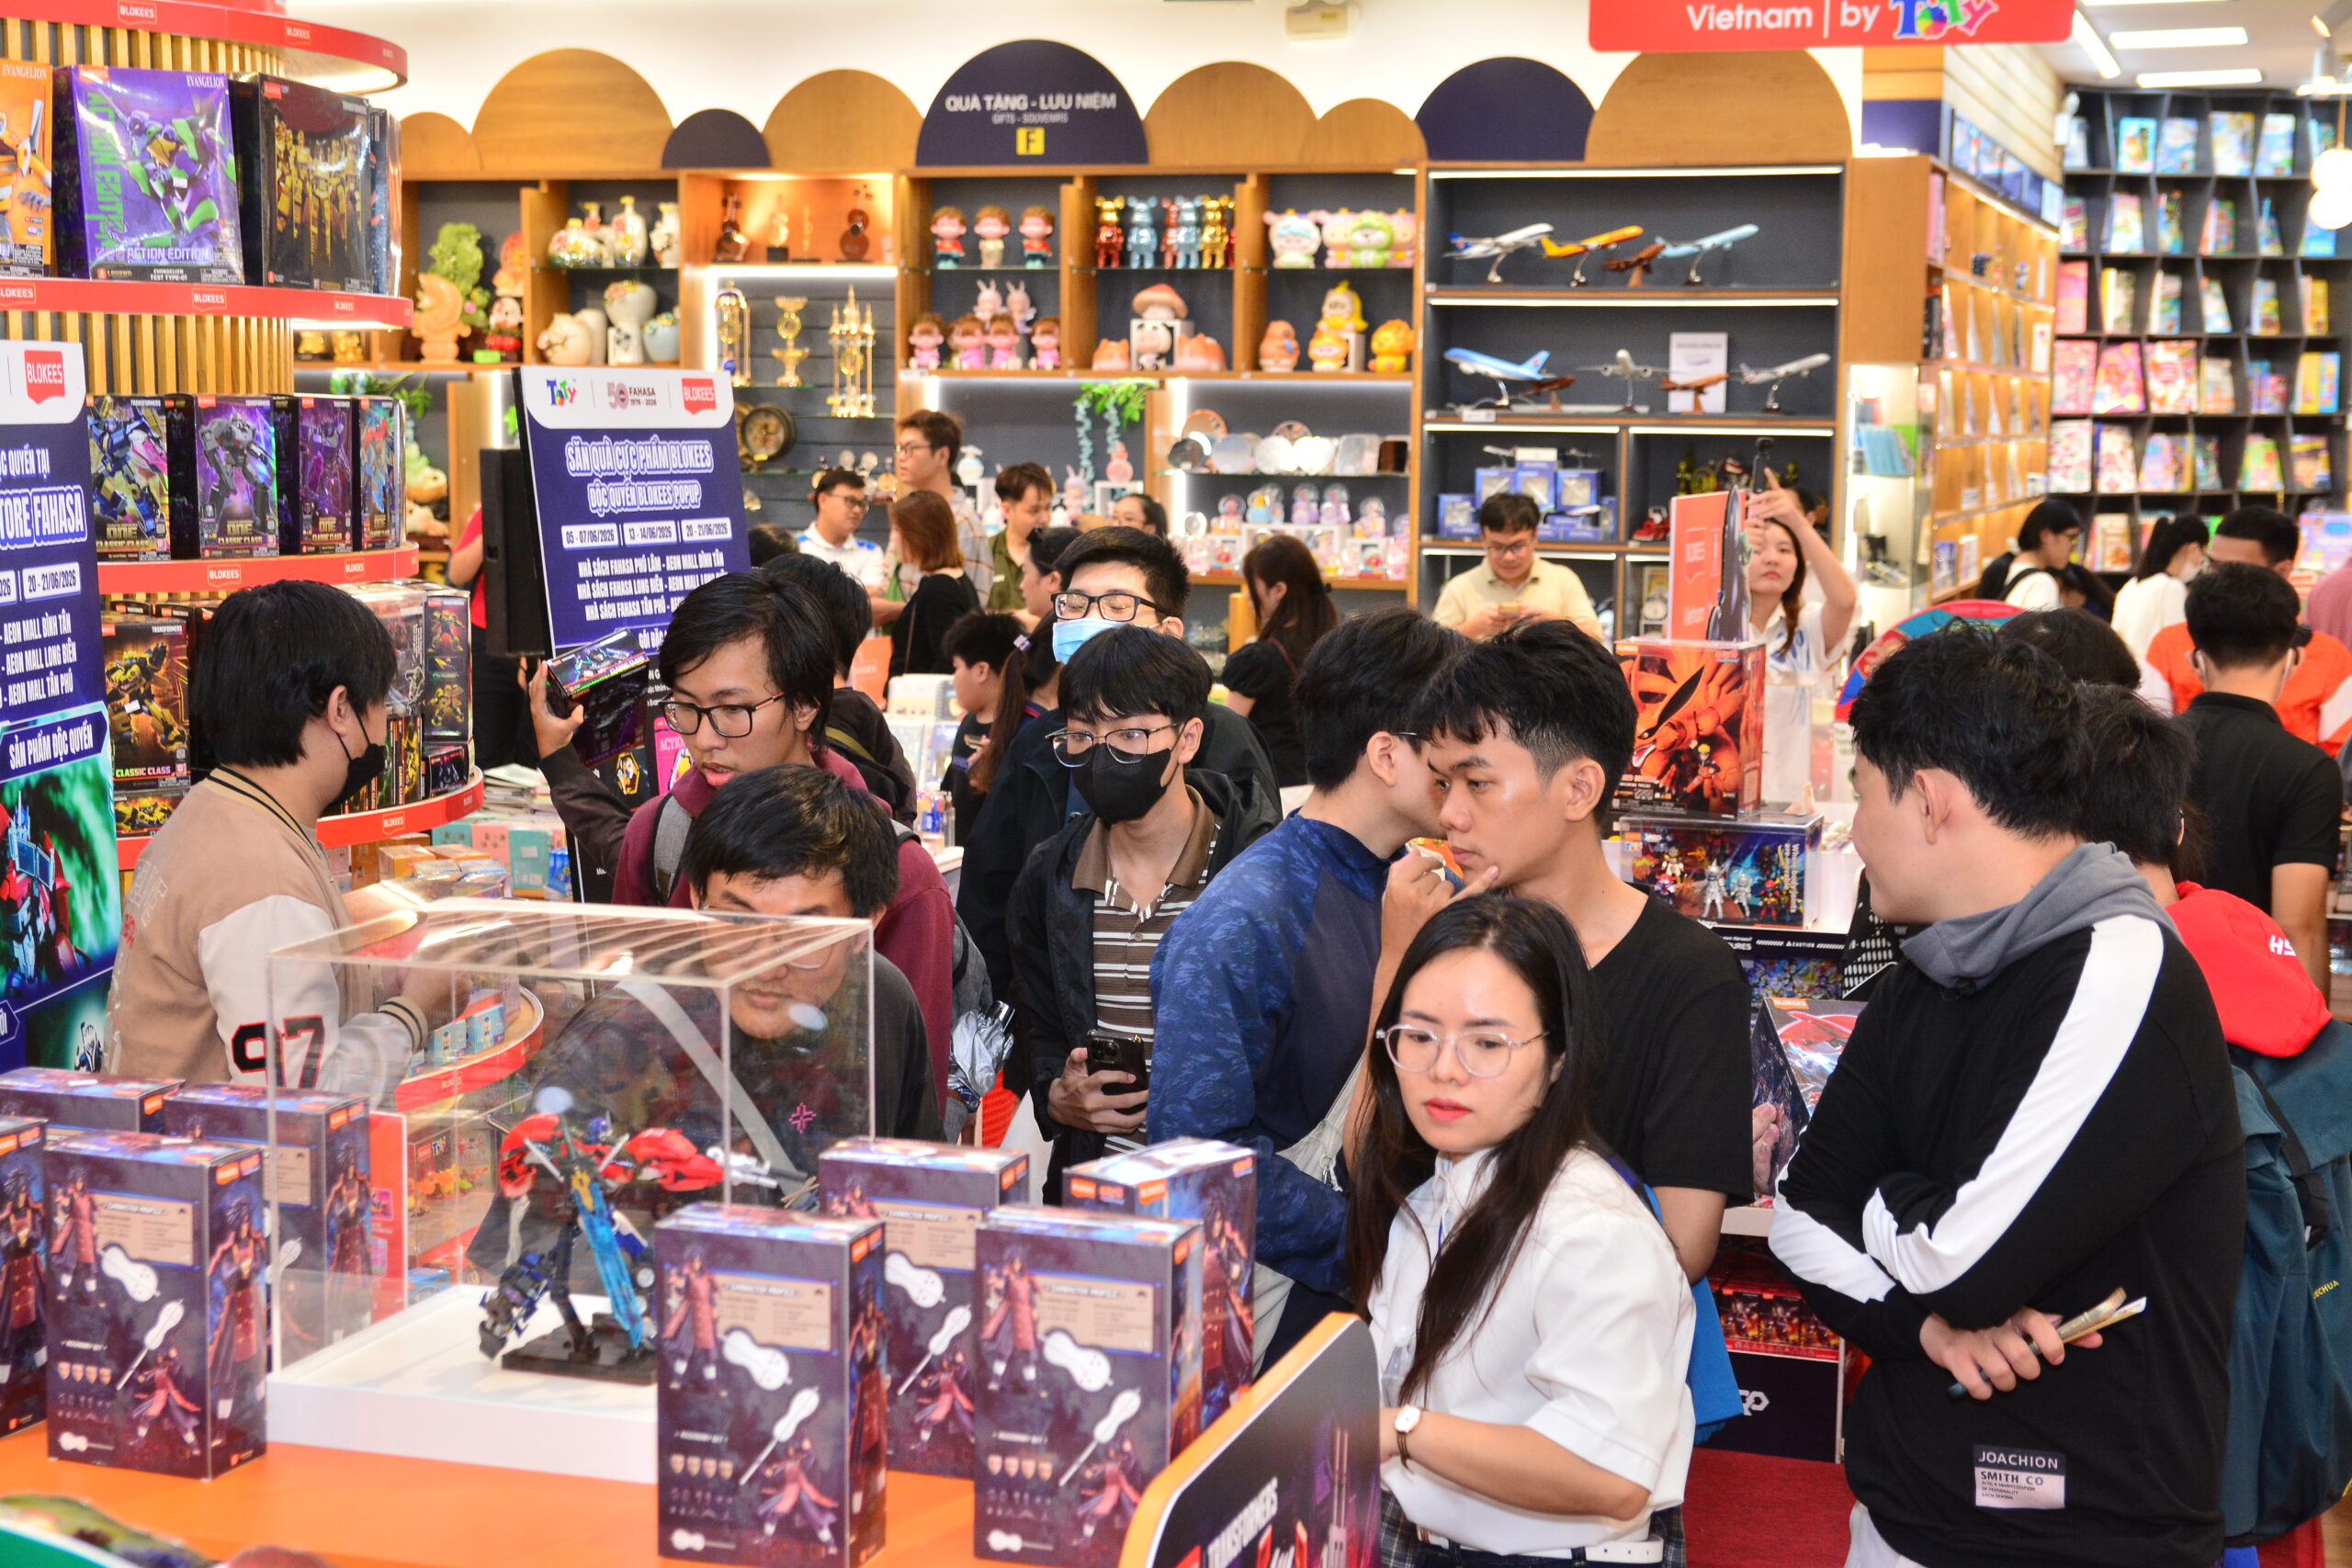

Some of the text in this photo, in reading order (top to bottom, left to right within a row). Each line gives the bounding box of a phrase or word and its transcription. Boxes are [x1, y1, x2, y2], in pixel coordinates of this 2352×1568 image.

[119, 6, 154, 18] BLOKEES
[1687, 5, 1813, 30] Vietnam
[1840, 3, 1879, 31] by
[286, 27, 310, 39] BLOKEES
[2, 65, 47, 78] EVANGELION
[187, 74, 225, 88] EVANGELION
[127, 247, 209, 259] ACTION EDITION
[0, 288, 34, 299] LOKEES
[194, 293, 224, 304] BLOKEES
[26, 362, 63, 385] BLOKEES
[607, 382, 656, 410] 50 FAHASA
[684, 385, 715, 402] BLOKEES
[8, 443, 36, 477] QUYỀN
[36, 448, 50, 479] TẠI
[568, 437, 712, 477] SĂN QUÀ CỰC PHẨM BLOKEES
[589, 479, 700, 514] ĐỘC QUYỀN BLOKEES POPUP
[0, 492, 85, 540] TORE FAHASA
[566, 528, 615, 544] 05 07/06/2026
[629, 525, 672, 540] 13 14/06/2026
[686, 523, 728, 536] 20 21/06/2026
[243, 536, 262, 544] CLASS
[209, 570, 239, 580] BLOKEES
[345, 564, 364, 573] BLOKEES
[578, 558, 593, 578] NHÀ
[593, 557, 611, 577] SÁCH
[611, 557, 635, 575] FAHASA
[666, 555, 682, 570] AEON
[682, 554, 698, 570] MALL
[28, 576, 37, 592] 20
[42, 570, 77, 592] 21/06/2026
[577, 581, 591, 600] NHÀ
[592, 580, 609, 599] SÁCH
[610, 579, 634, 597] FAHASA
[634, 578, 649, 595] LONG
[668, 575, 684, 592] AEON
[684, 574, 699, 591] MALL
[585, 601, 600, 621] NHÀ
[599, 600, 616, 620] SÁCH
[616, 600, 641, 618] FAHASA
[653, 595, 666, 614] PHÚ
[4, 608, 72, 645] AEON MALL BÌNH TÂN
[6, 637, 77, 675] AEON MALL LONG BIÊN
[8, 682, 27, 706] AEON
[27, 678, 46, 702] MALL
[46, 671, 60, 699] TÂN
[61, 667, 74, 694] PHÚ
[9, 719, 94, 771] SẢN PHẨM ĐỘC QUYỀN
[116, 765, 171, 778] CLASSIC CLASS
[383, 813, 404, 828] BLOKEES
[1773, 998, 1807, 1008] BLOKEES
[232, 1015, 324, 1089] 97
[2313, 1280, 2339, 1300] ECHUA
[1978, 1450, 2058, 1470] JOACHION
[1980, 1471, 2044, 1486] SMITH CO
[1208, 1476, 1278, 1568] TRANSFORMERS
